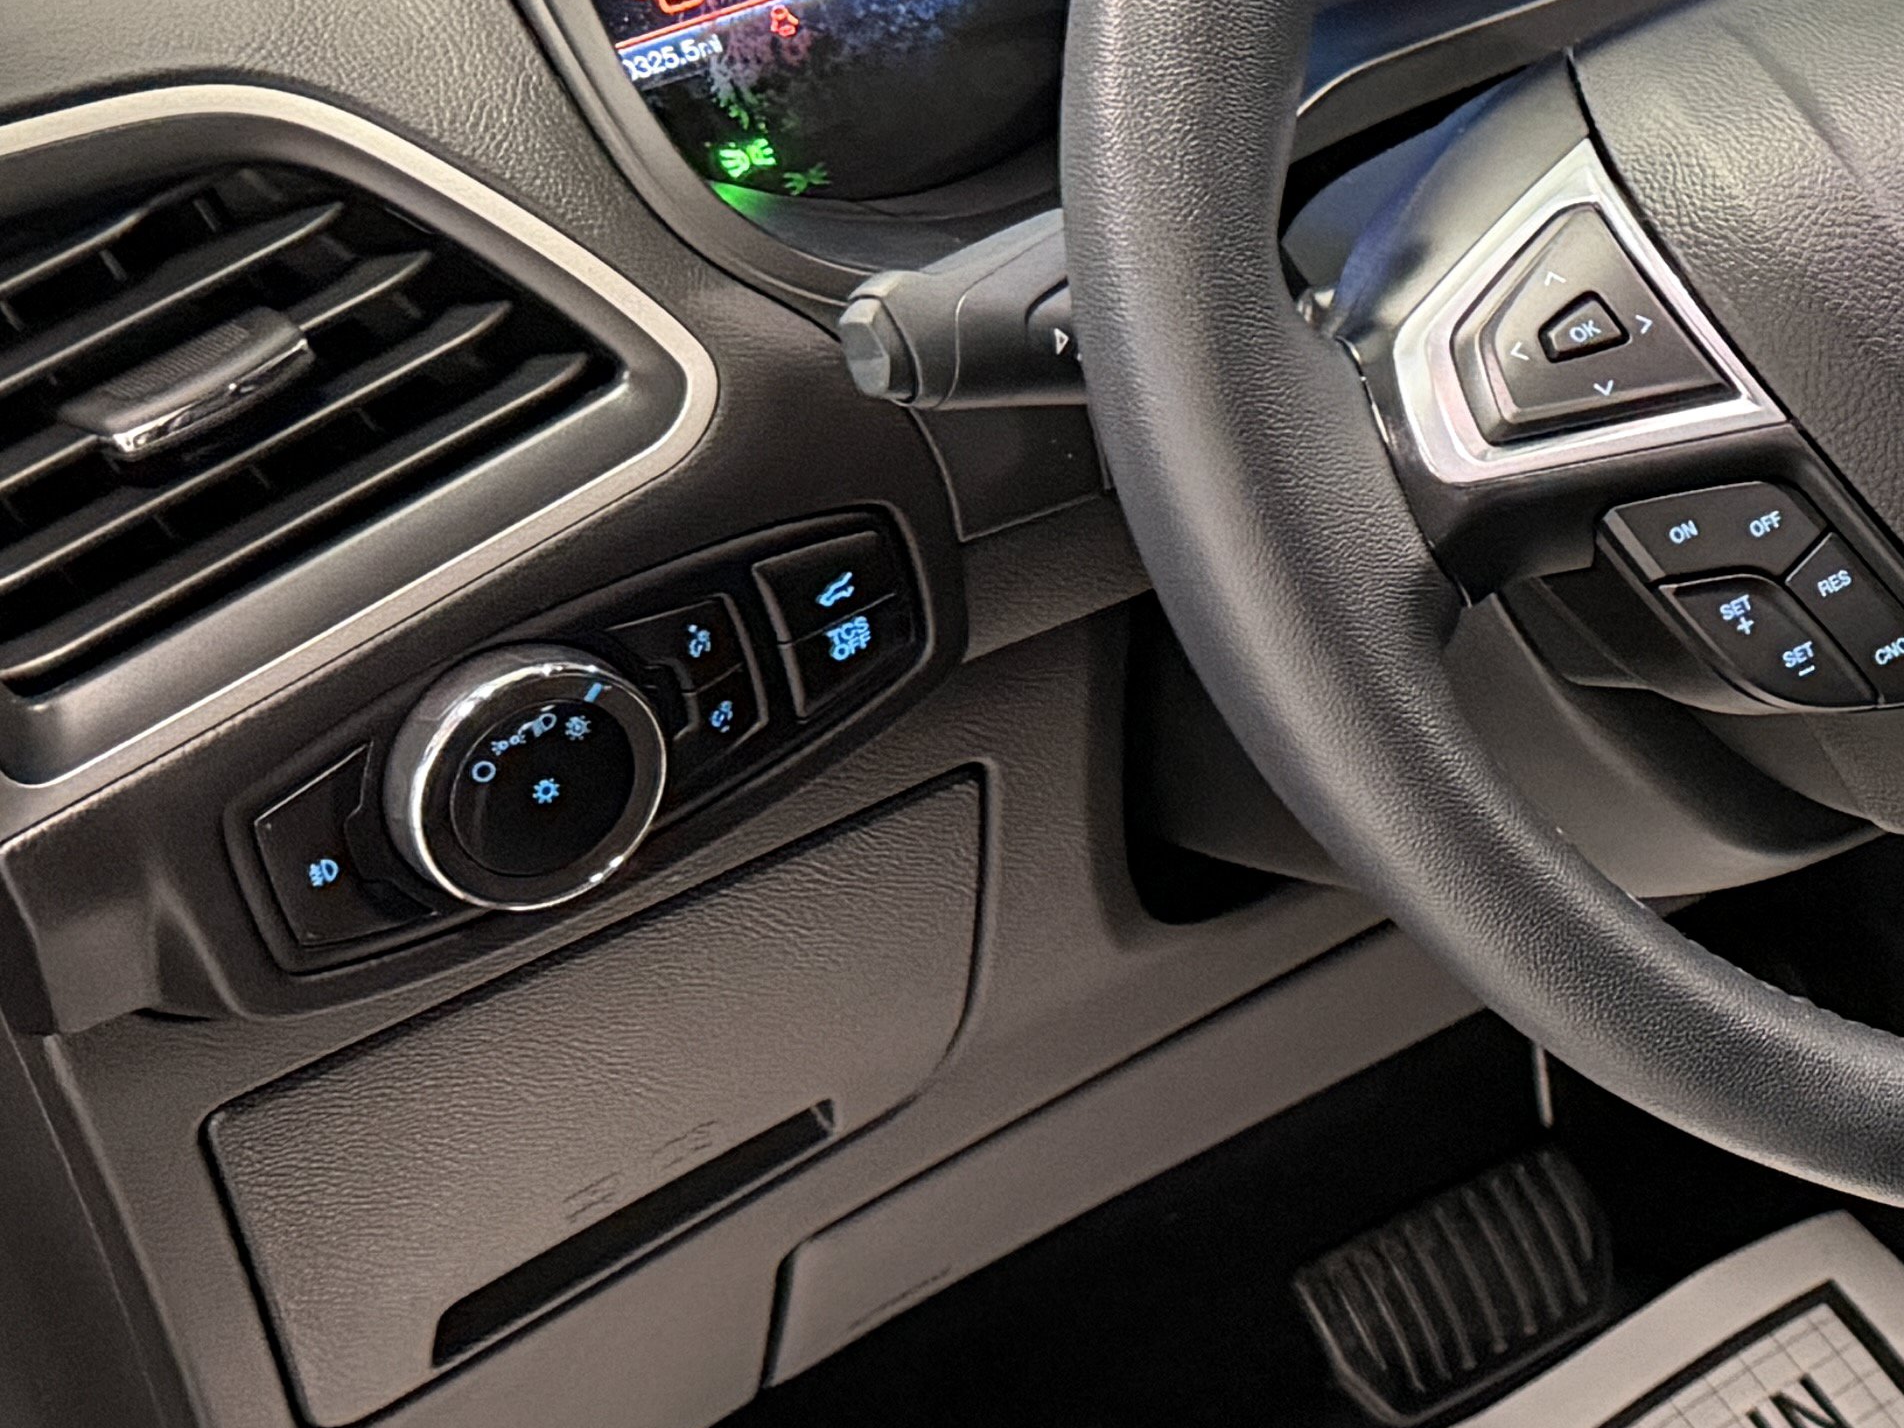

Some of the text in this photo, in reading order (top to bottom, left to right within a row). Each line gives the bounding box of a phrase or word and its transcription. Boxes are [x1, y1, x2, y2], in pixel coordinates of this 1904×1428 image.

[1569, 320, 1602, 345] OK
[1669, 510, 1782, 546] ON OFF
[1816, 569, 1852, 598] RES
[1719, 594, 1752, 622] SET
[826, 616, 869, 645] TCS
[831, 631, 871, 660] OFF
[1782, 641, 1815, 669] SET
